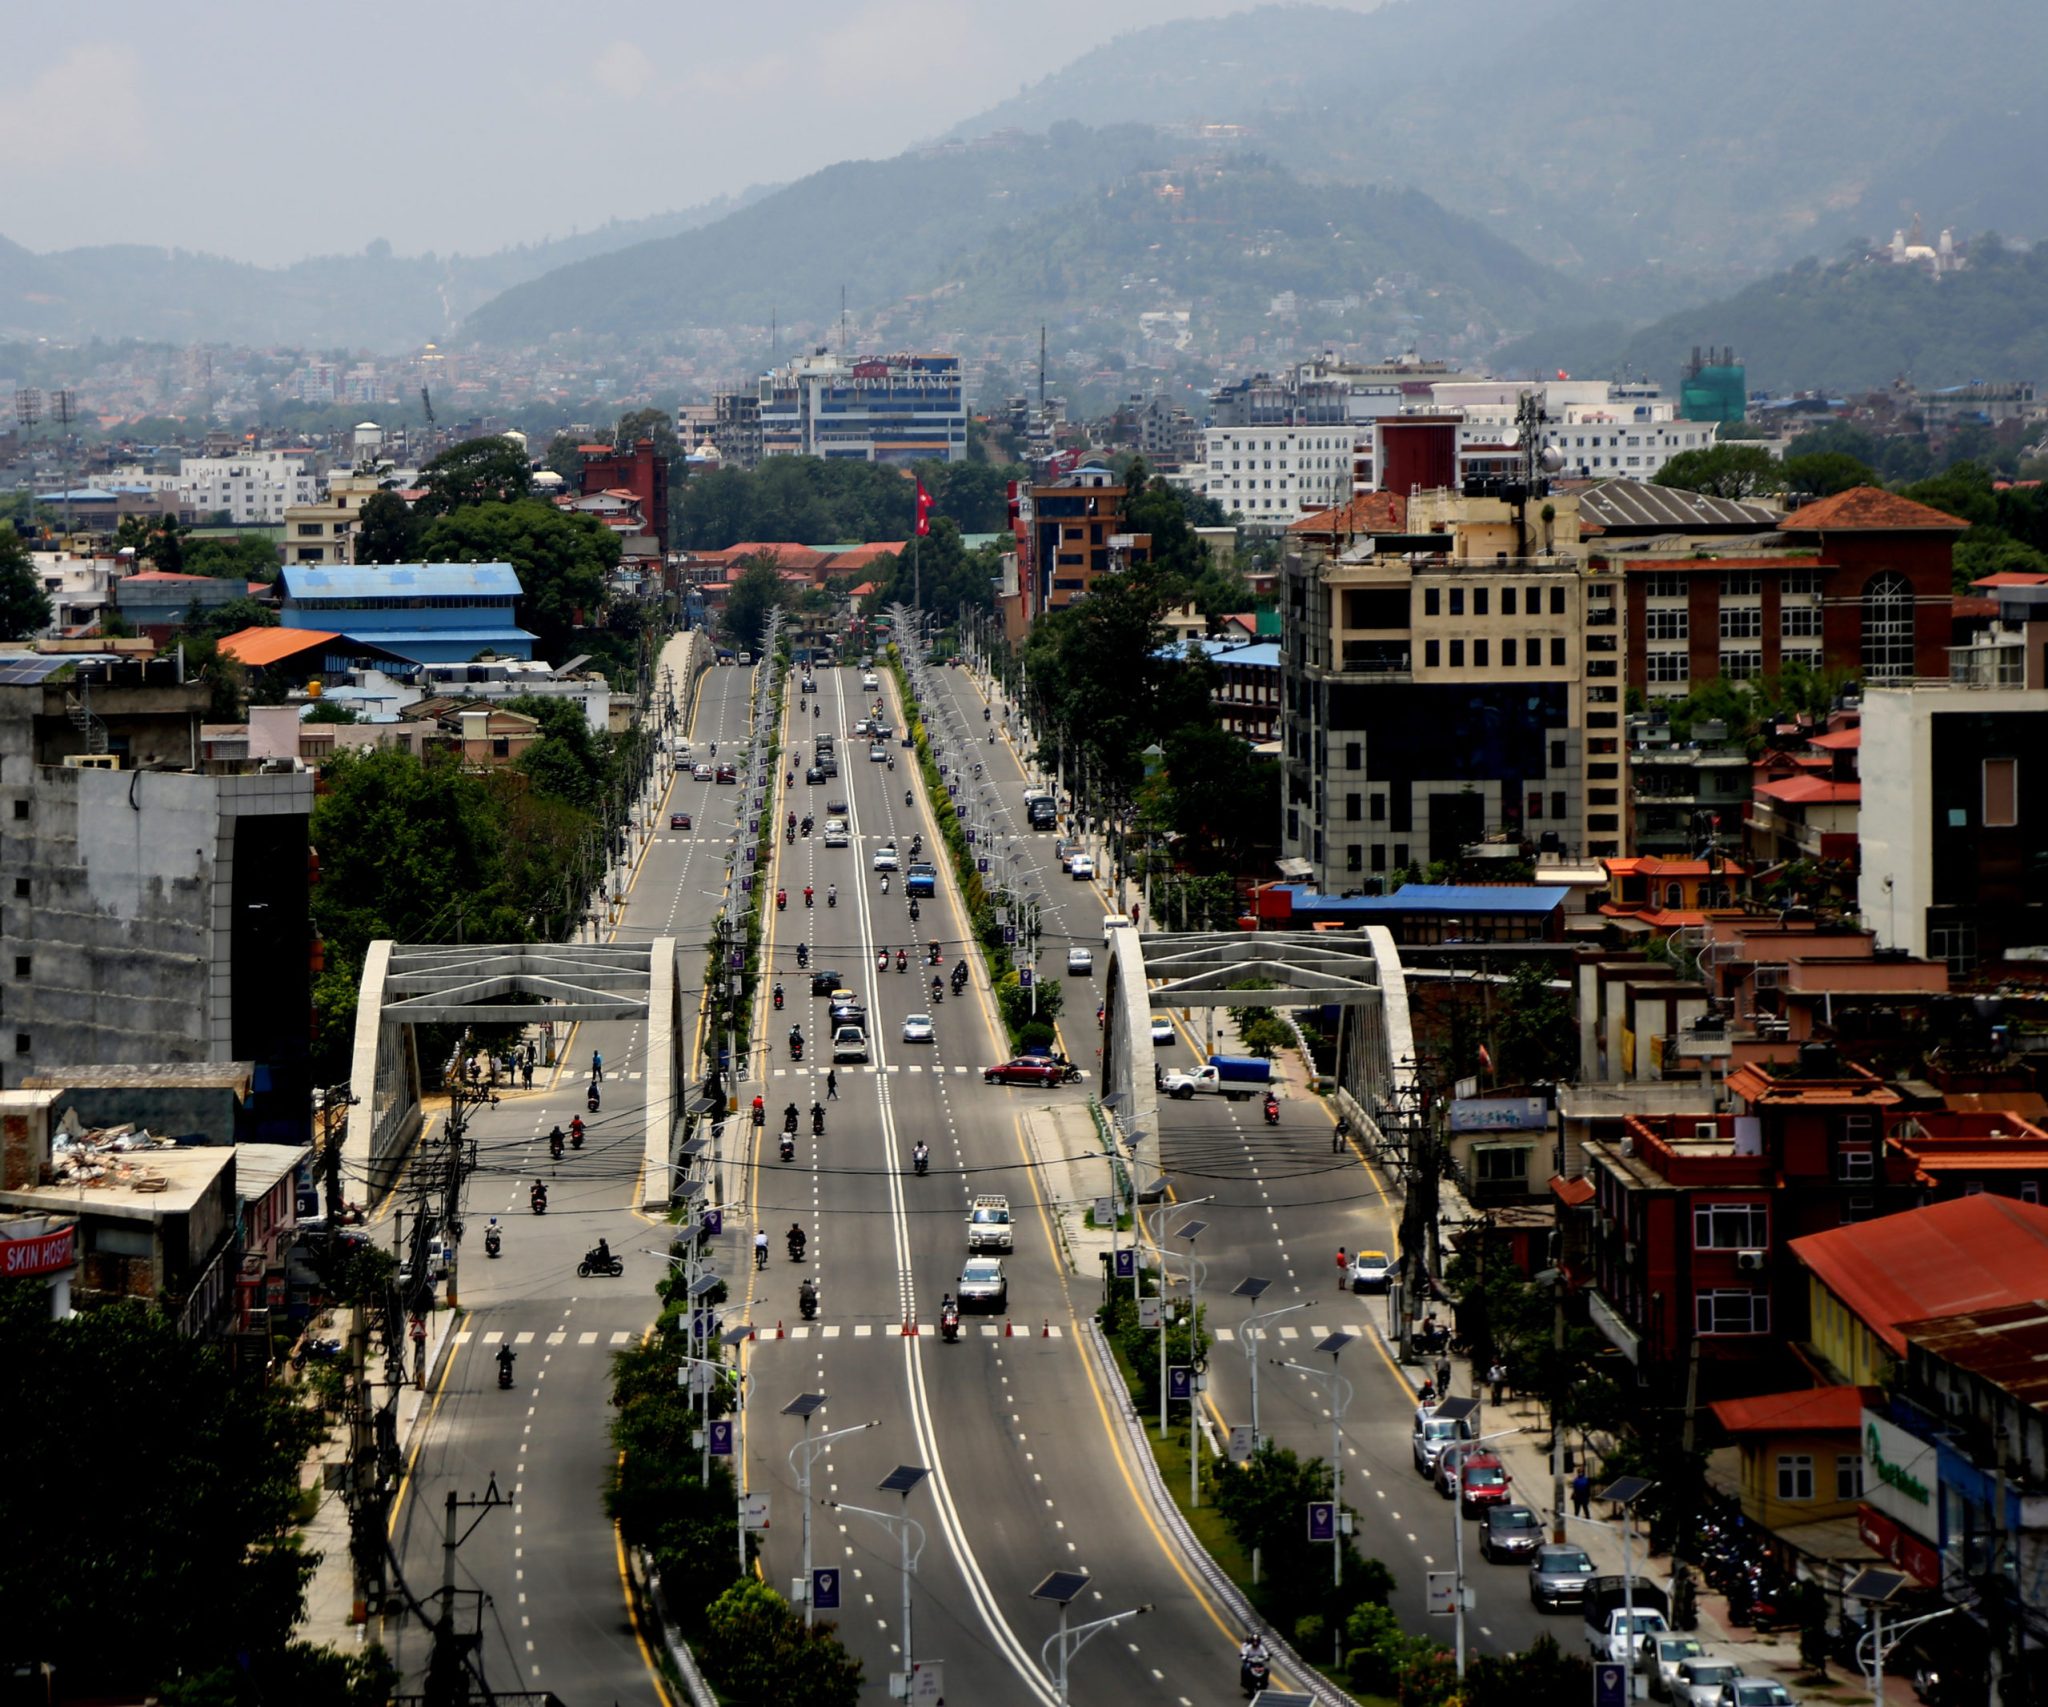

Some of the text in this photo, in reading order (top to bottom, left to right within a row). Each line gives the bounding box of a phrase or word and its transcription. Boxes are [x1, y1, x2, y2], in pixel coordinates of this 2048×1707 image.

[852, 376, 949, 390] CIVIL BANK
[7, 1244, 39, 1271] SKIN
